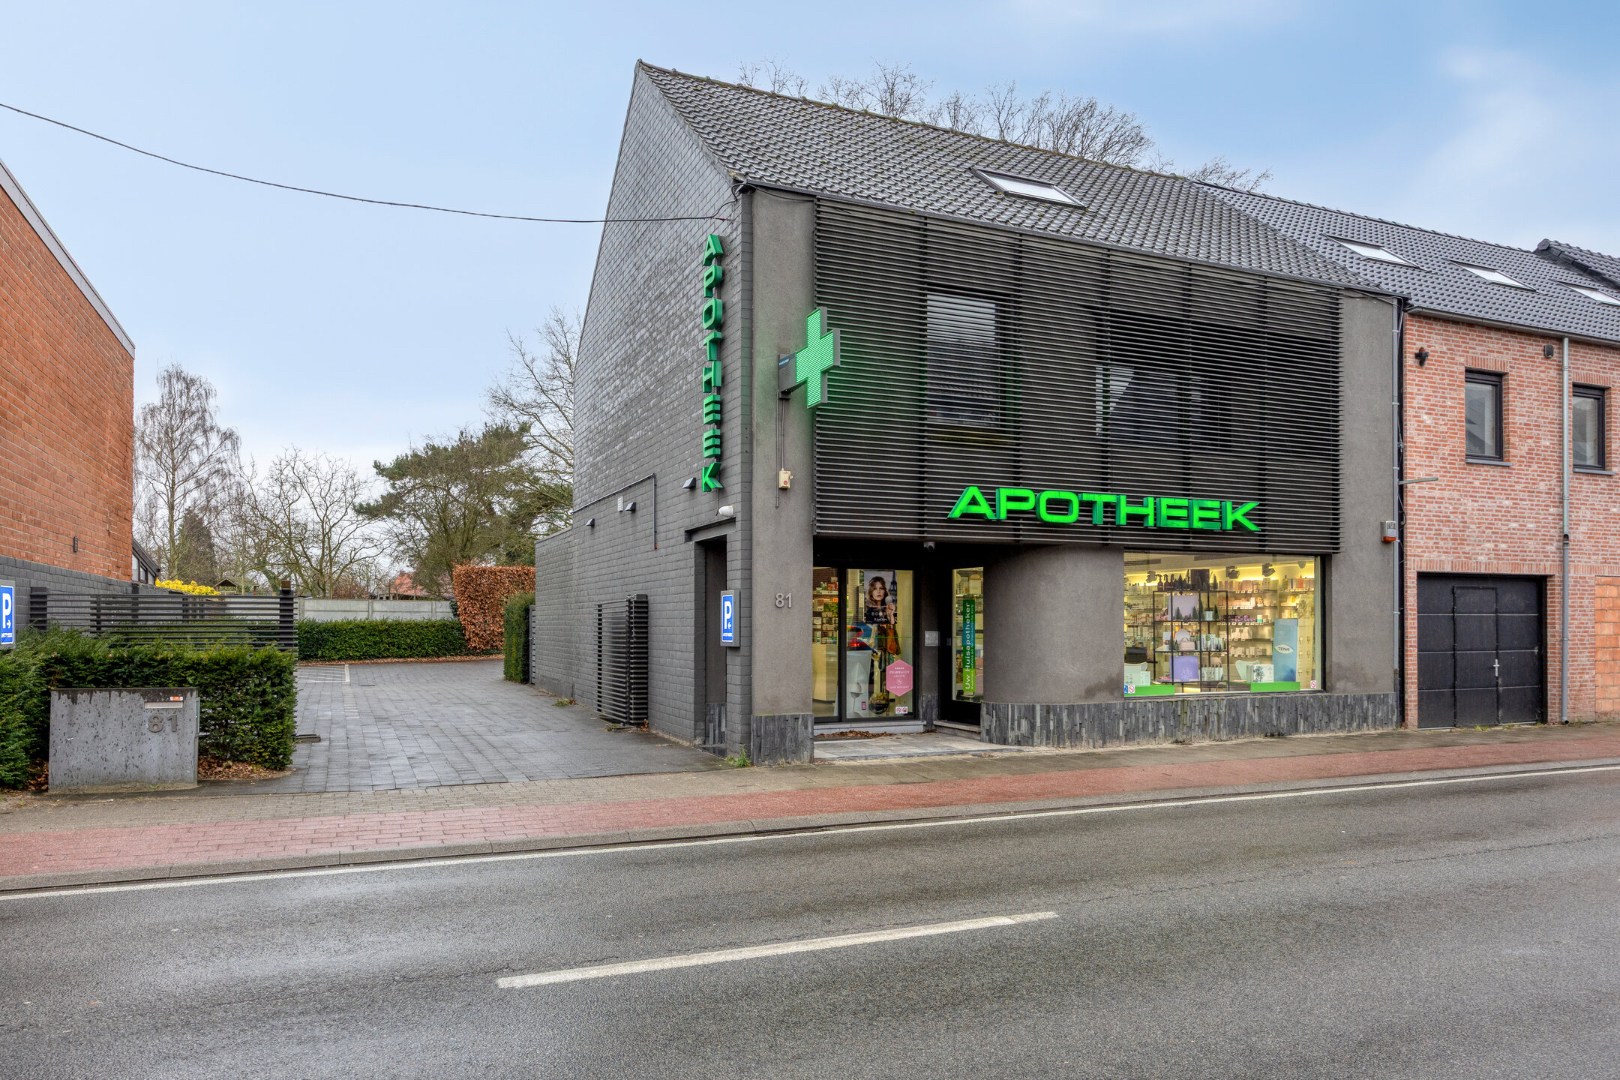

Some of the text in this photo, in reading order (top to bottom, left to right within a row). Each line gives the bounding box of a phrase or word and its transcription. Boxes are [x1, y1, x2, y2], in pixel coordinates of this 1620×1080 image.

[702, 234, 723, 492] APOTHEEK
[947, 486, 1261, 531] APOTHEEK
[2, 592, 12, 629] P
[724, 600, 732, 630] P
[775, 592, 792, 608] 81
[965, 674, 971, 690] Uw
[149, 714, 178, 733] 81
